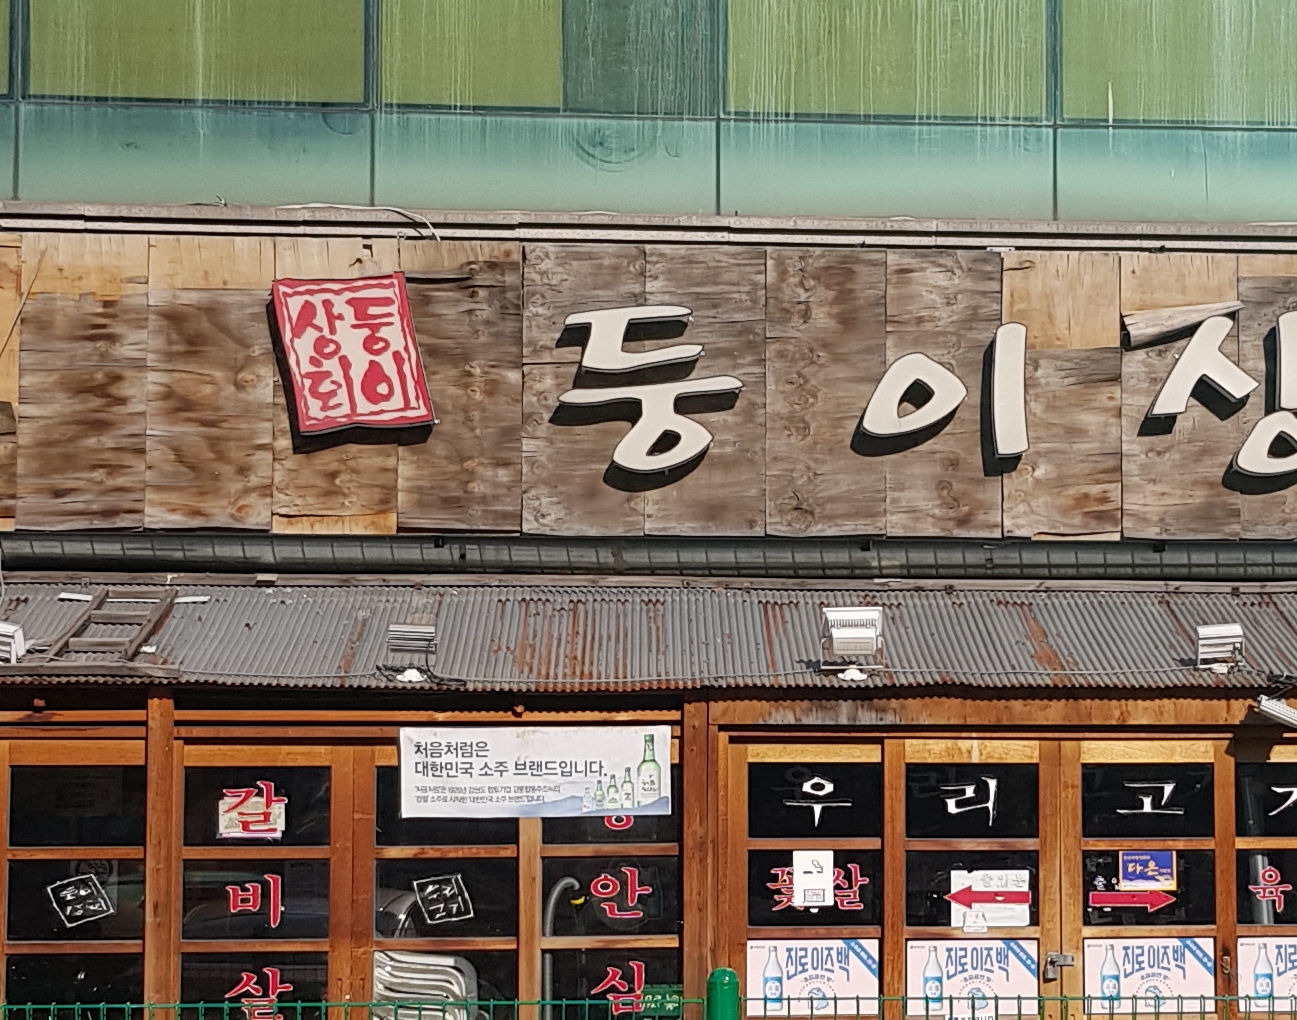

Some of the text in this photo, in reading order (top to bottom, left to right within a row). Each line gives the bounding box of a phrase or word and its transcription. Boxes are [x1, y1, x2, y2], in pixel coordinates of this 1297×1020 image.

[413, 740, 490, 759] 처음처럼은
[414, 760, 475, 779] 대한민국
[478, 761, 510, 779] 소주
